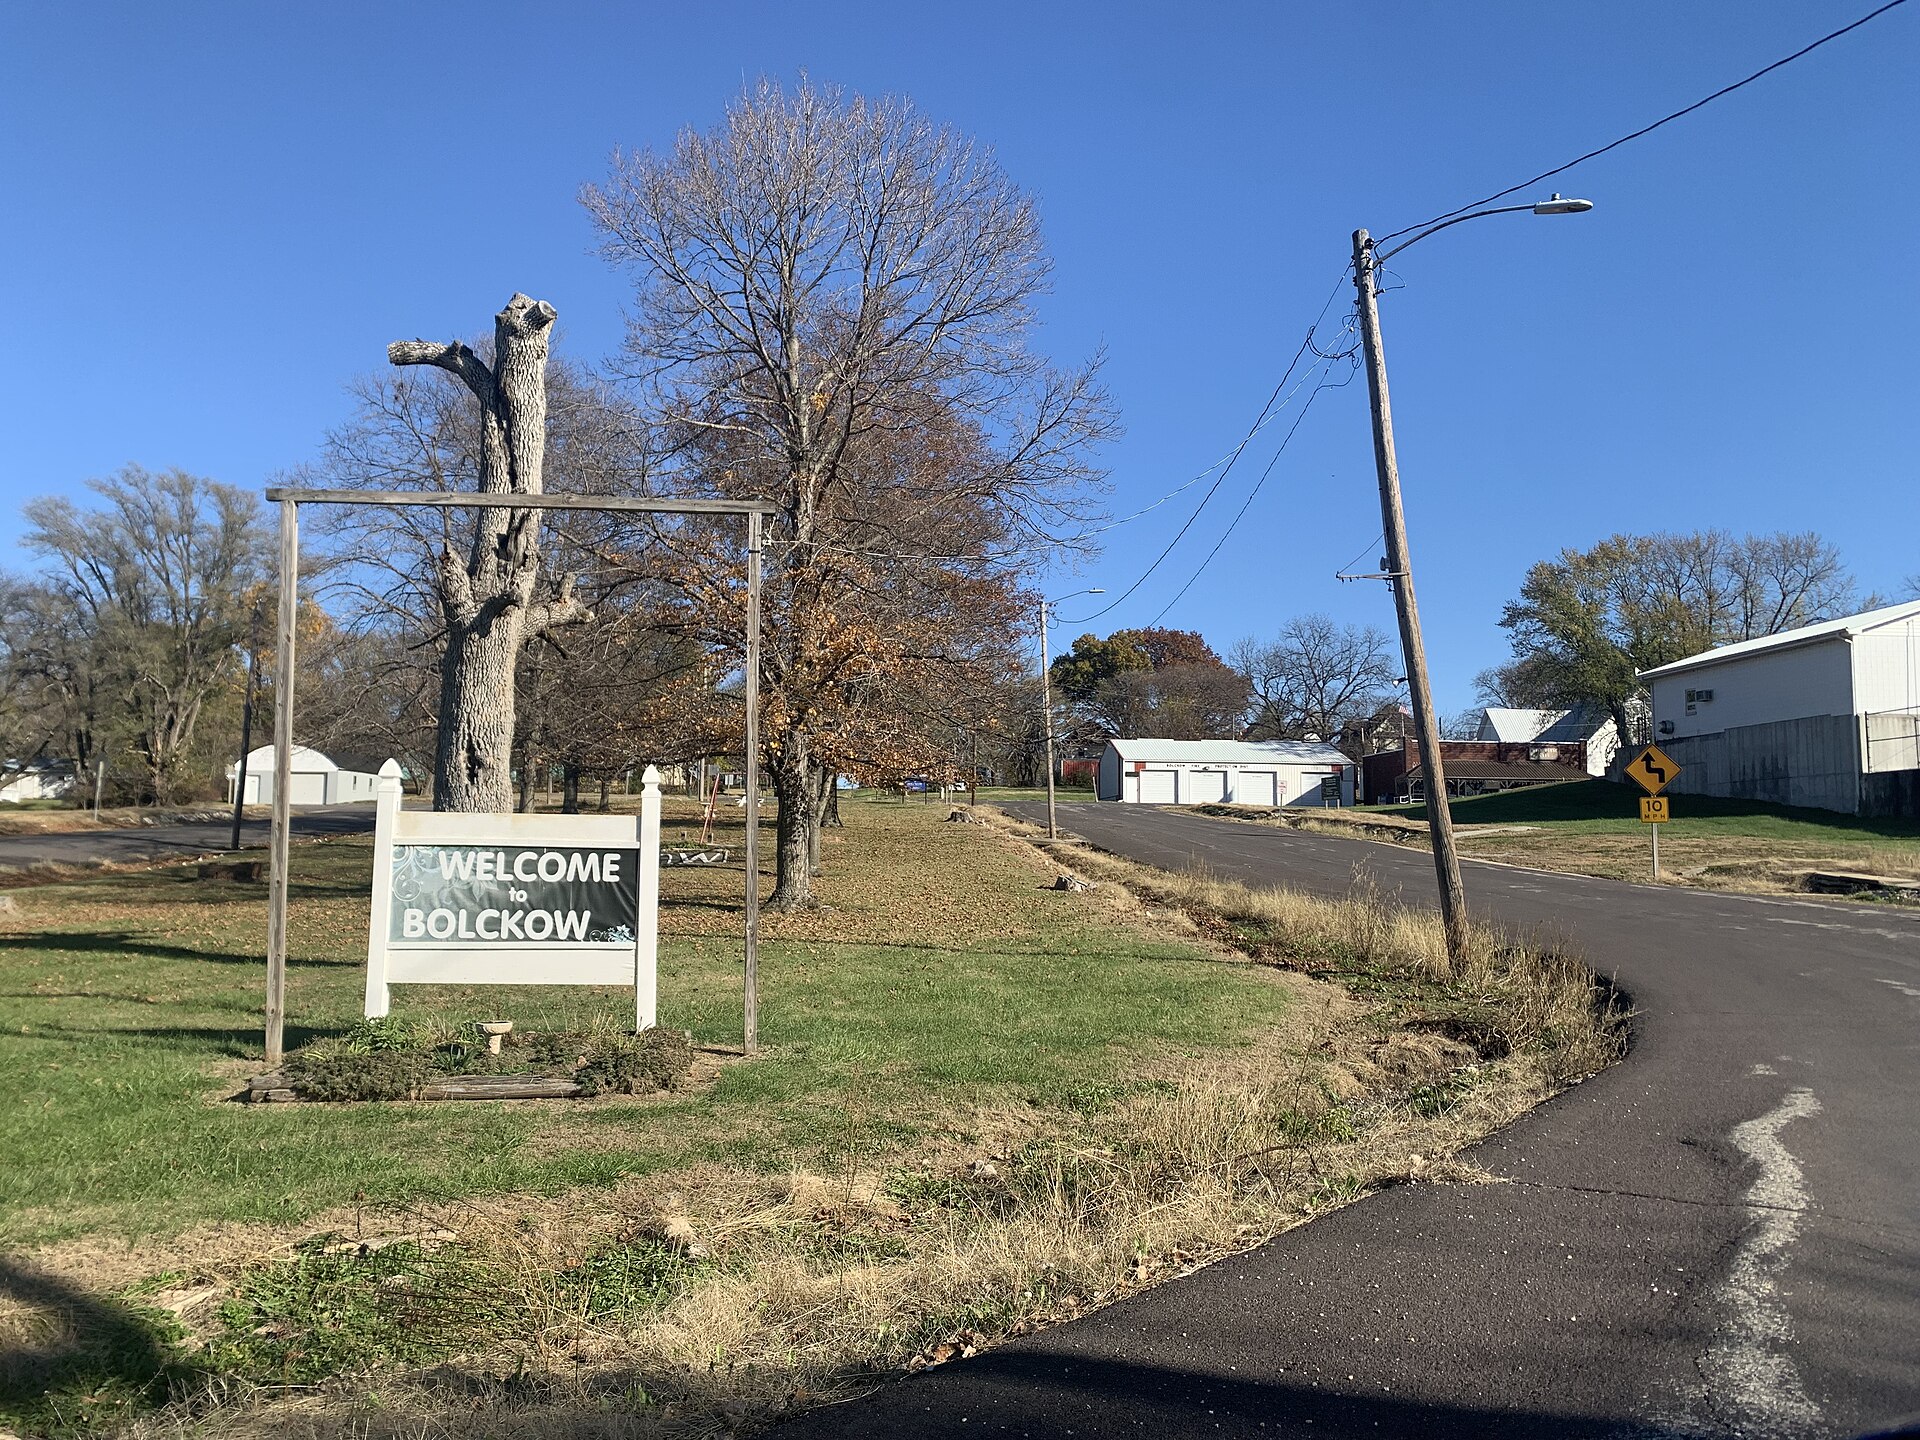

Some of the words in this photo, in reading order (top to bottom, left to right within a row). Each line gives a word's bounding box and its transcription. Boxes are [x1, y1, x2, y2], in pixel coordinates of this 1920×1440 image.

[1646, 800, 1662, 812] 10
[439, 850, 621, 883] WELCOME
[508, 887, 528, 903] to
[402, 908, 591, 940] BOLCKOW
